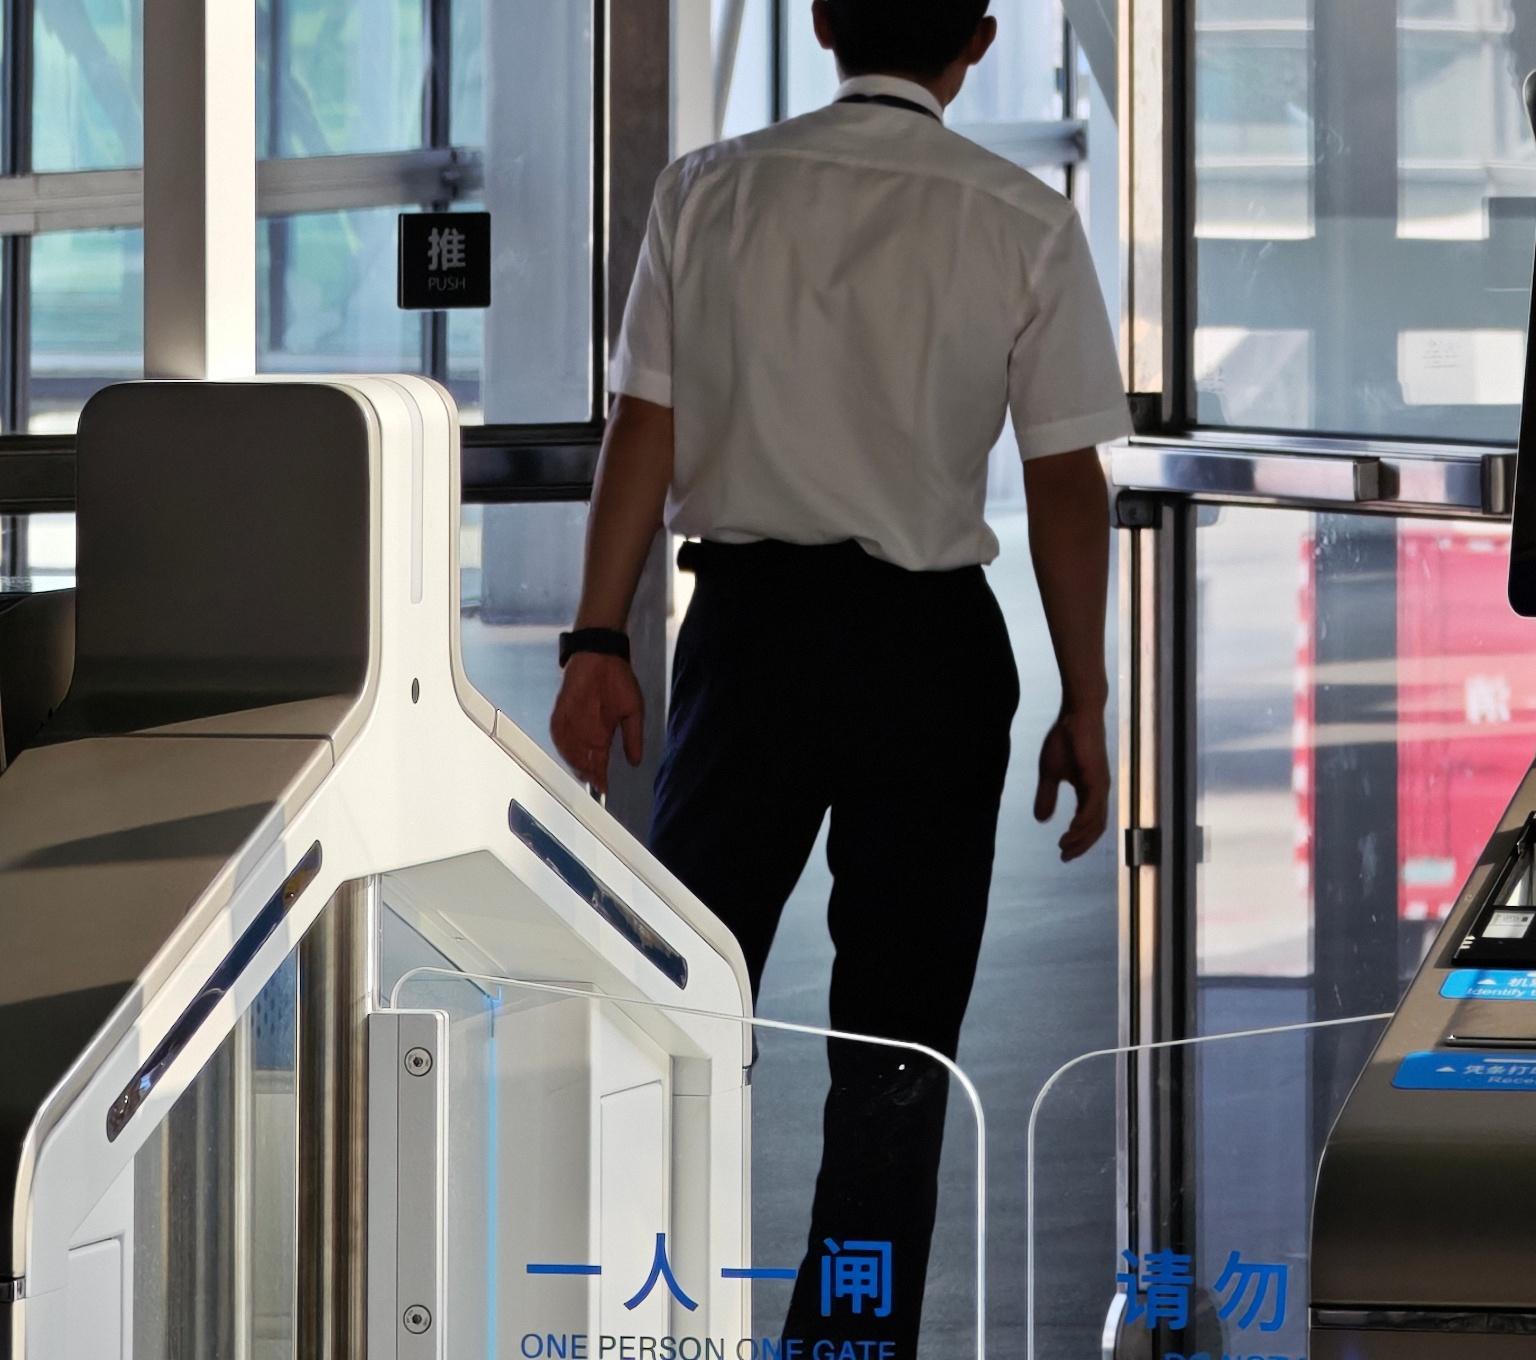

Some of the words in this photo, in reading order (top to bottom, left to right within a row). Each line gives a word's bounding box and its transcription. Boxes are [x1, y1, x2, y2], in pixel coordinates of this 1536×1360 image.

[428, 228, 466, 270] 推
[428, 277, 465, 291] PUSH
[526, 1233, 893, 1317] 一人一闸
[1115, 1249, 1289, 1331] 请勿
[521, 1334, 588, 1360] ONE
[600, 1336, 726, 1360] PERSON
[736, 1338, 803, 1360] ONE
[812, 1340, 896, 1360] GATE
